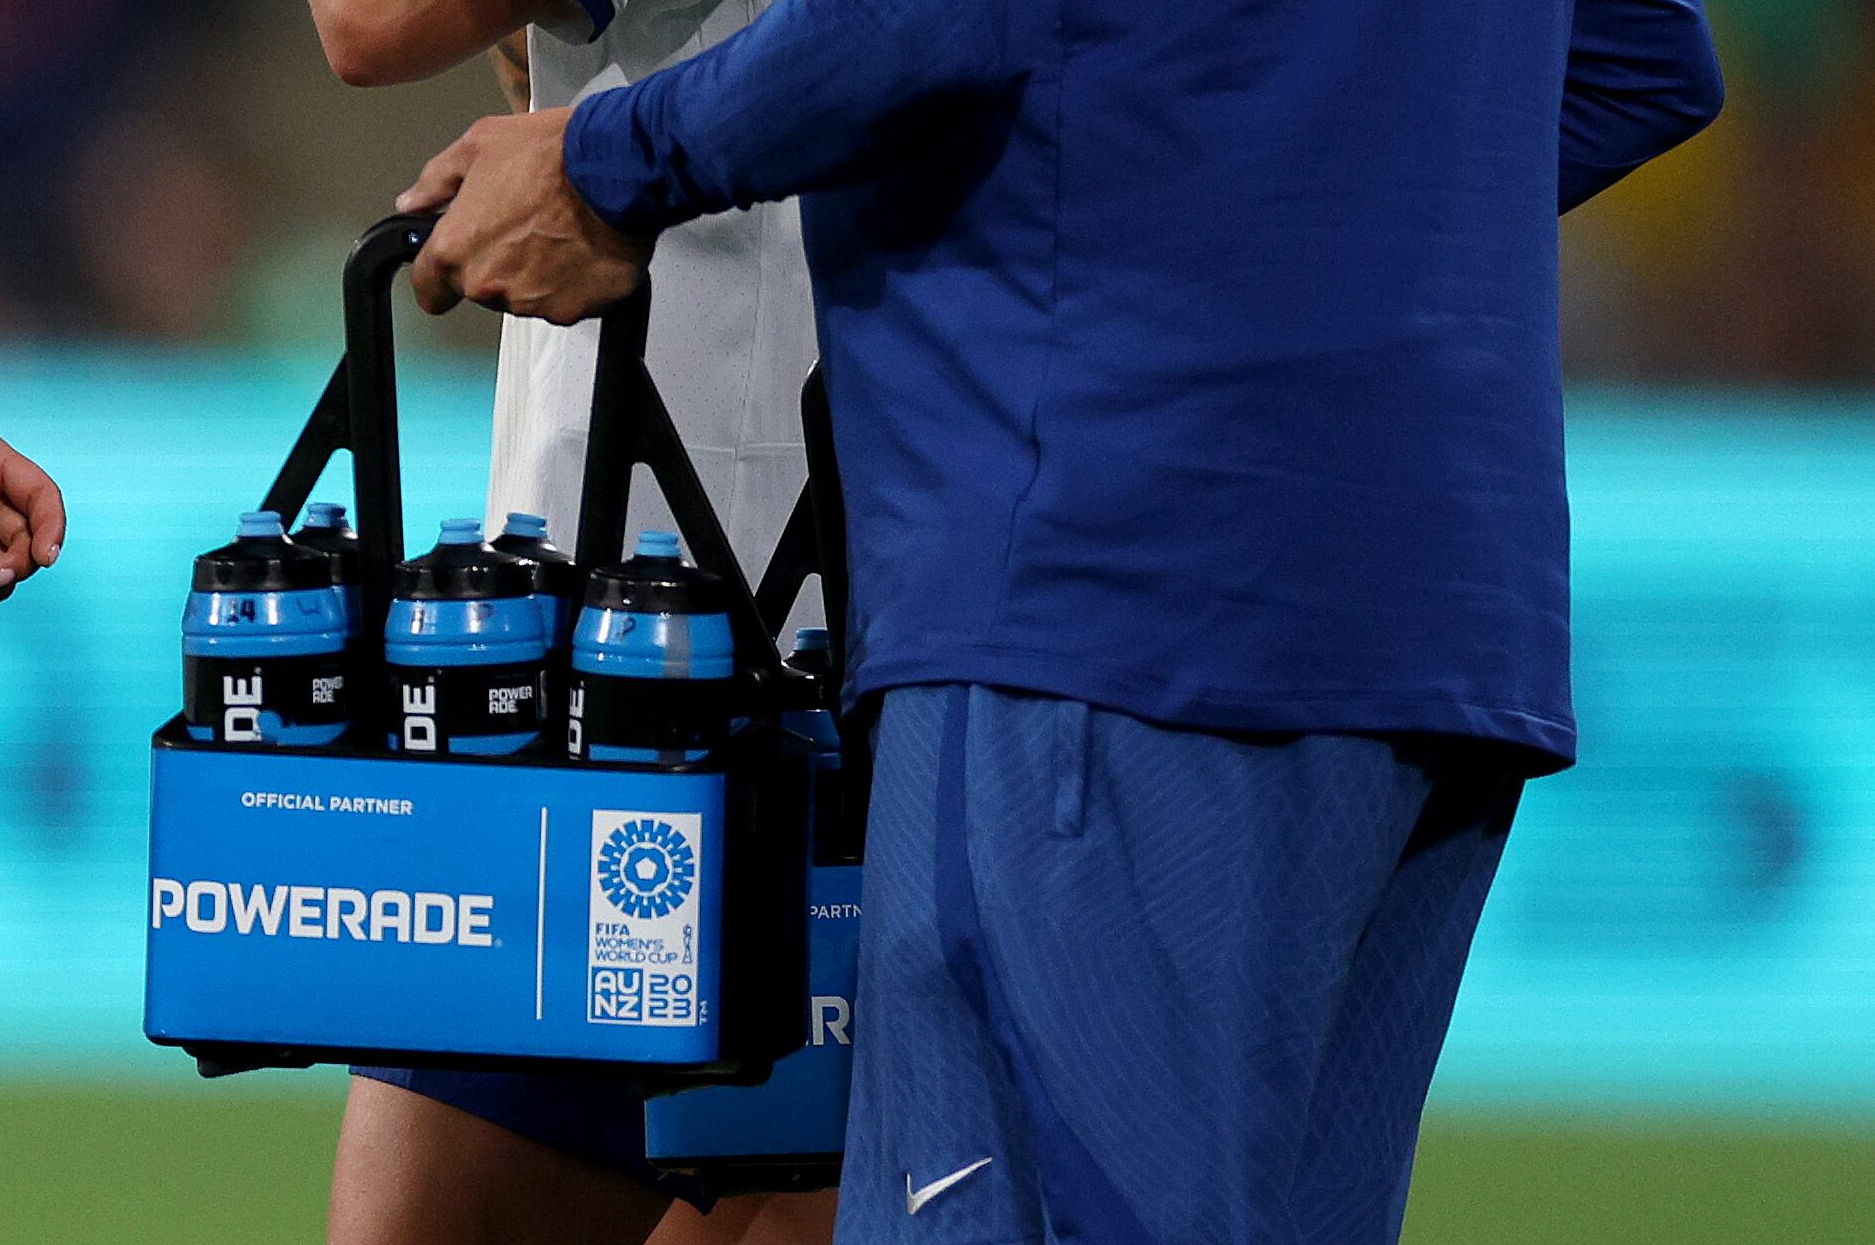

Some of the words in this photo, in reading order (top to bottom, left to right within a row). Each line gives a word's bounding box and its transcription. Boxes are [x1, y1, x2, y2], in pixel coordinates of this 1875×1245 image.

[488, 685, 534, 701] POWER
[488, 700, 519, 715] ADE
[241, 791, 325, 812] OFFICIAL
[329, 796, 414, 816] PARTNER
[152, 877, 495, 948] POWERADE
[595, 922, 630, 936] FIFA
[595, 937, 665, 951] WOMEN'S
[595, 949, 646, 963] WORLD
[648, 952, 678, 964] CUP
[594, 970, 640, 995] AU
[649, 974, 692, 995] 20
[594, 994, 639, 1018] NZ
[649, 998, 692, 1019] 23
